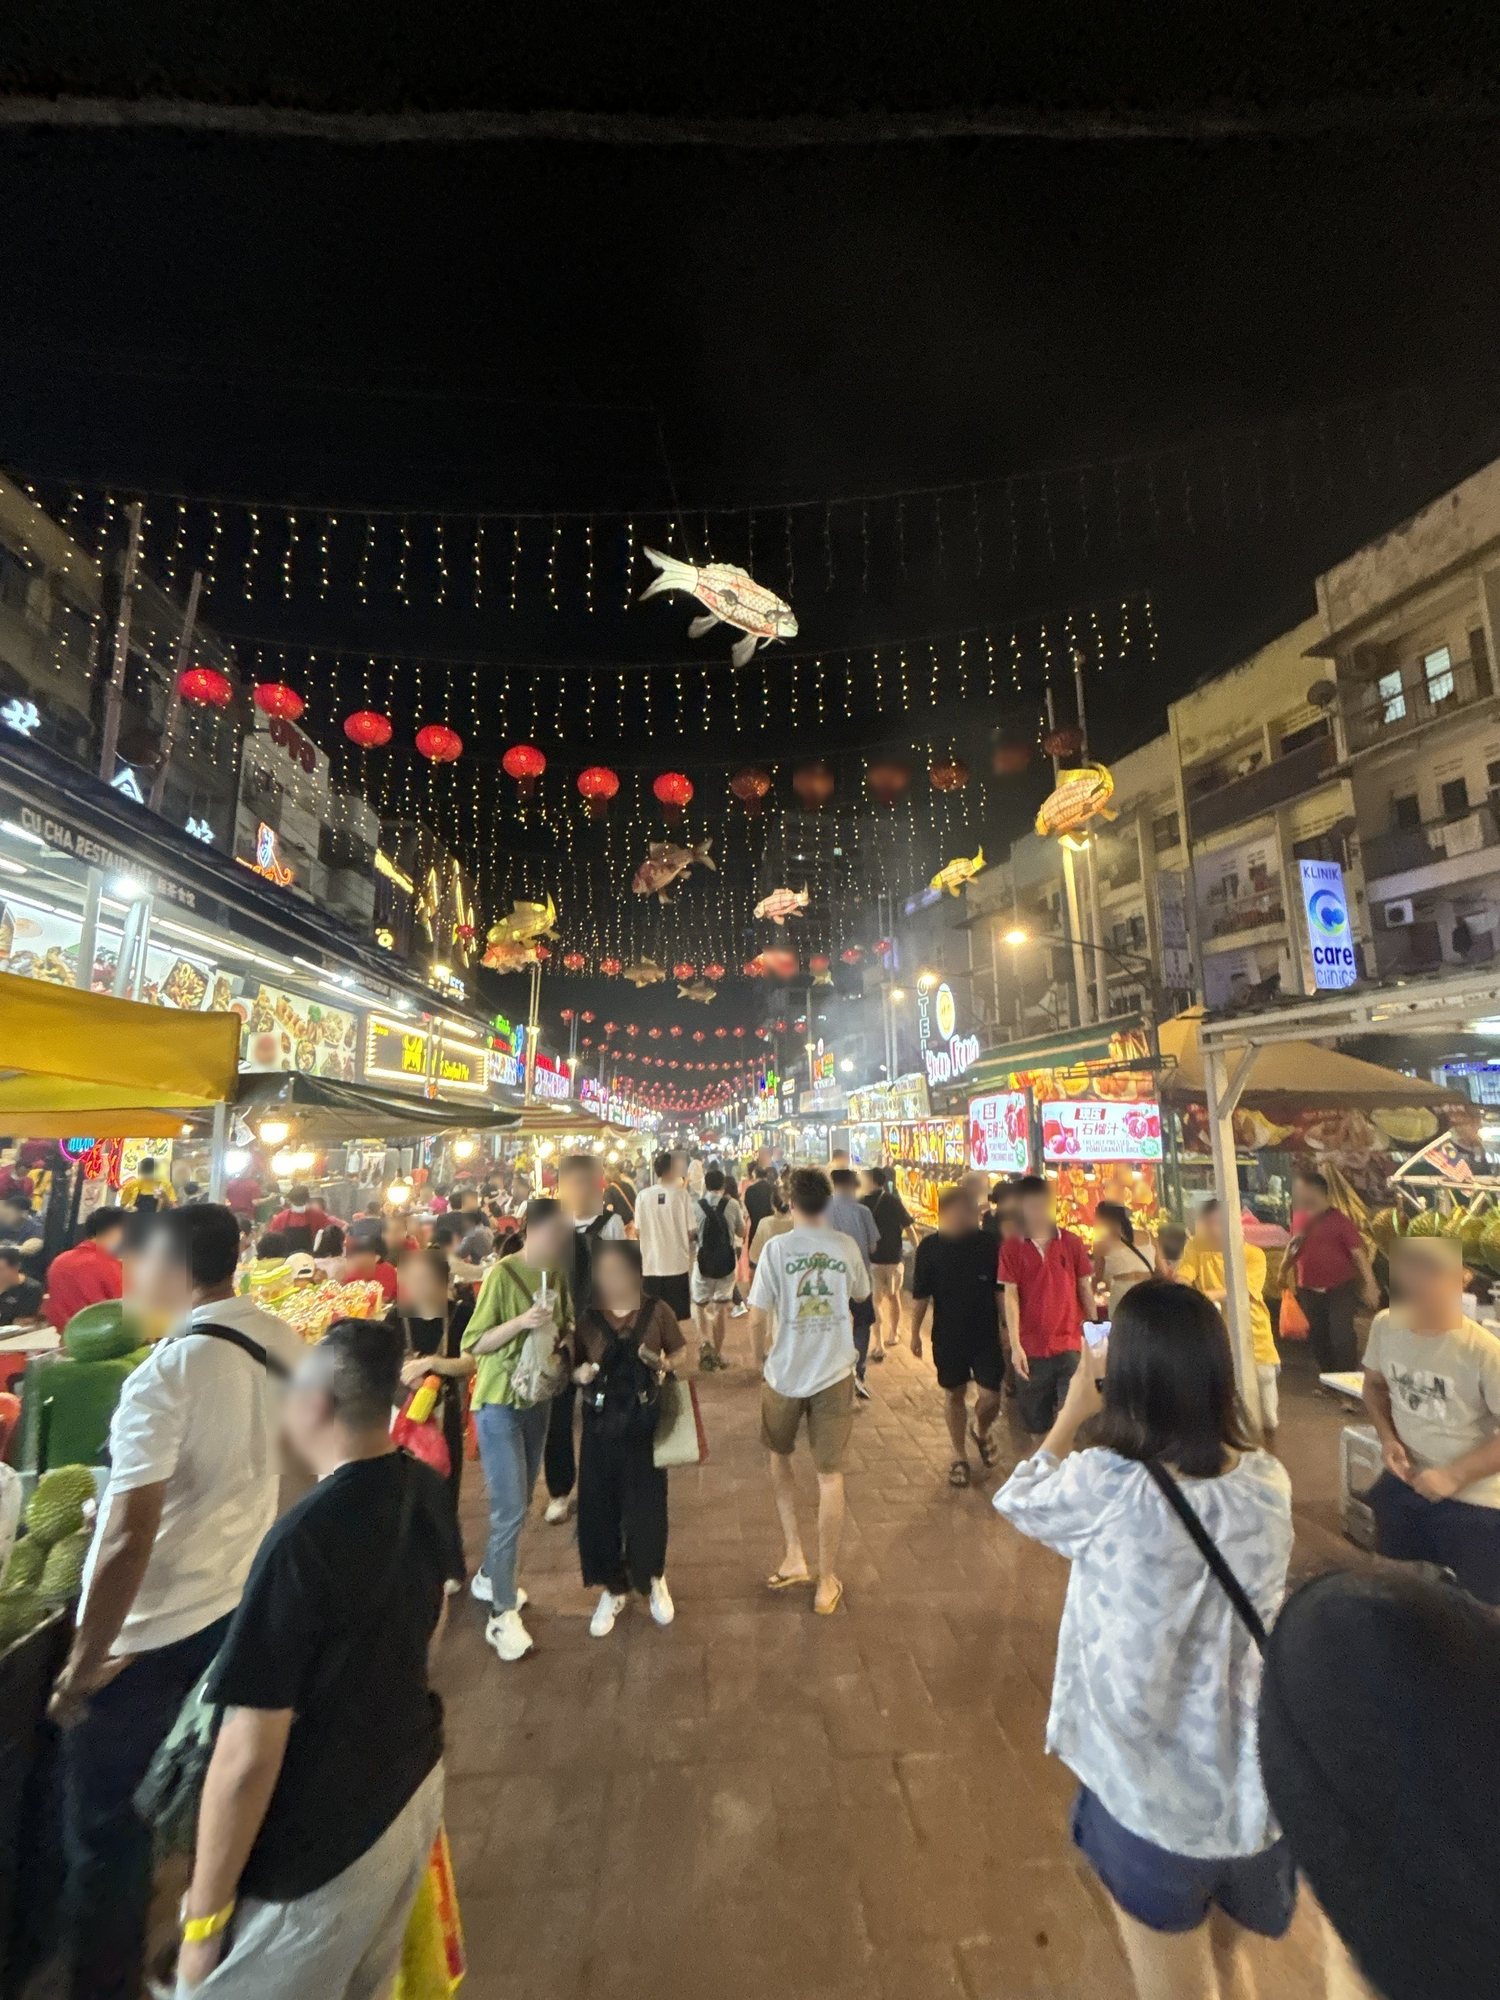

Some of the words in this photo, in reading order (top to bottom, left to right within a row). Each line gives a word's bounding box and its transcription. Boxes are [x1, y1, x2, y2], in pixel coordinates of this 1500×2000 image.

[21, 807, 41, 833] CU
[44, 820, 73, 850] CHA
[1303, 866, 1339, 880] KLINIK
[1313, 946, 1353, 966] care
[1082, 1122, 1119, 1137] 石榴汁
